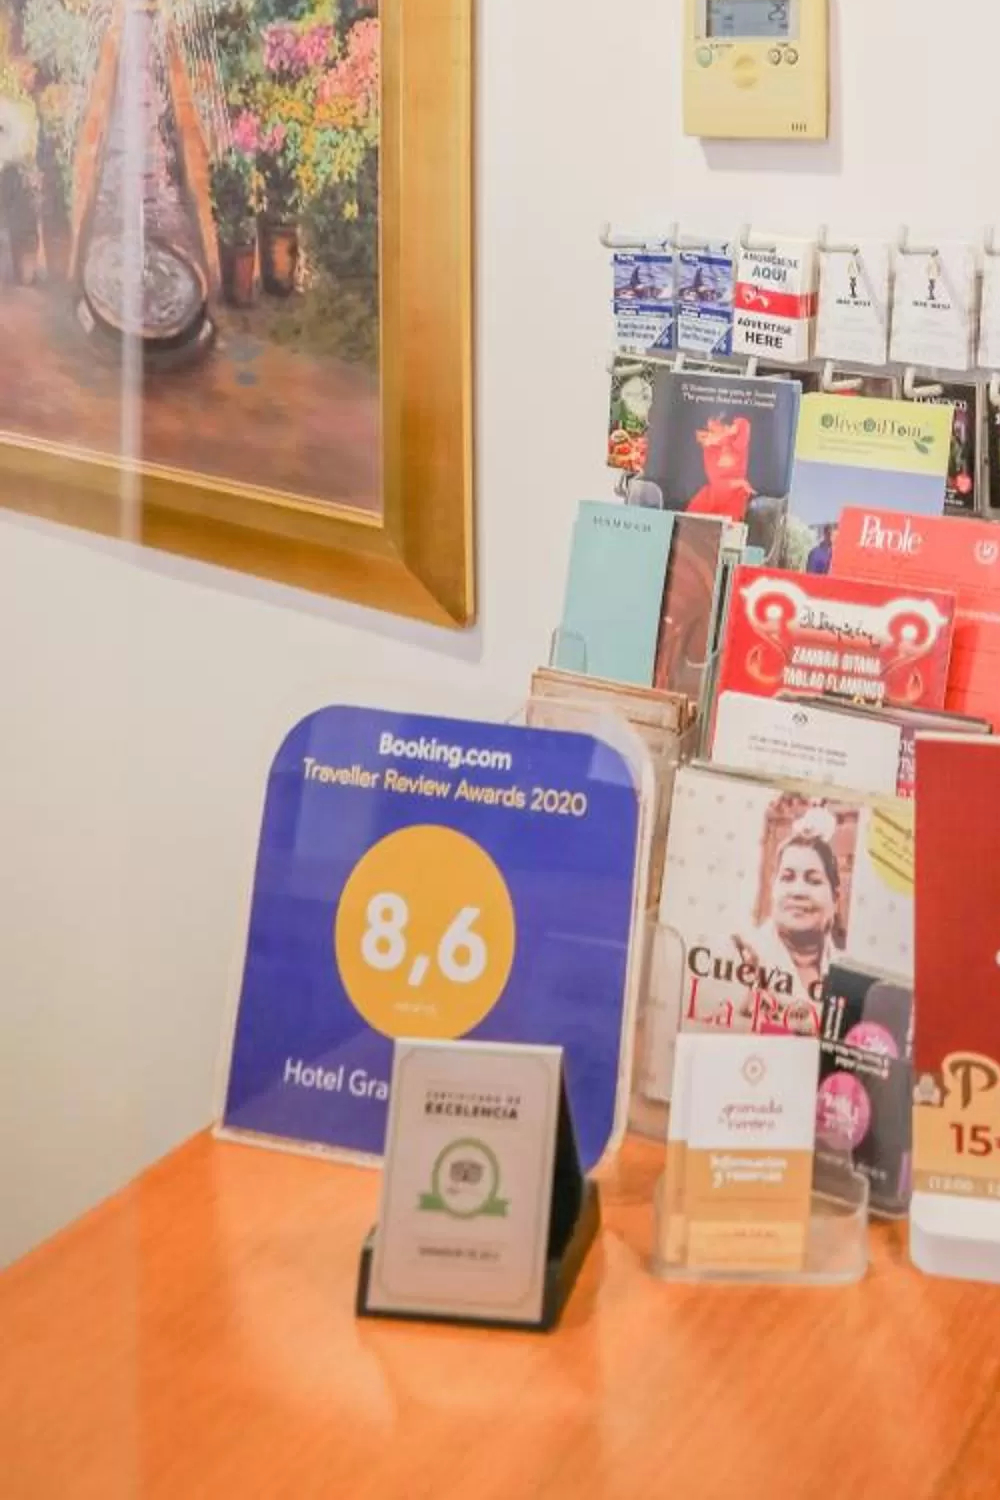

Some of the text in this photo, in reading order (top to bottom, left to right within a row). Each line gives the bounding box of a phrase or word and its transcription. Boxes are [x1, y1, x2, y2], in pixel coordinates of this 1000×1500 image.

[745, 332, 784, 349] HERE
[378, 731, 513, 771] Booking.com
[302, 757, 588, 817] Traveller Review Awards 2020
[360, 891, 488, 988] 8,6
[688, 945, 794, 996] Cueva
[283, 1057, 389, 1099] Hotel Gra
[425, 1101, 520, 1120] EXCELENCIA
